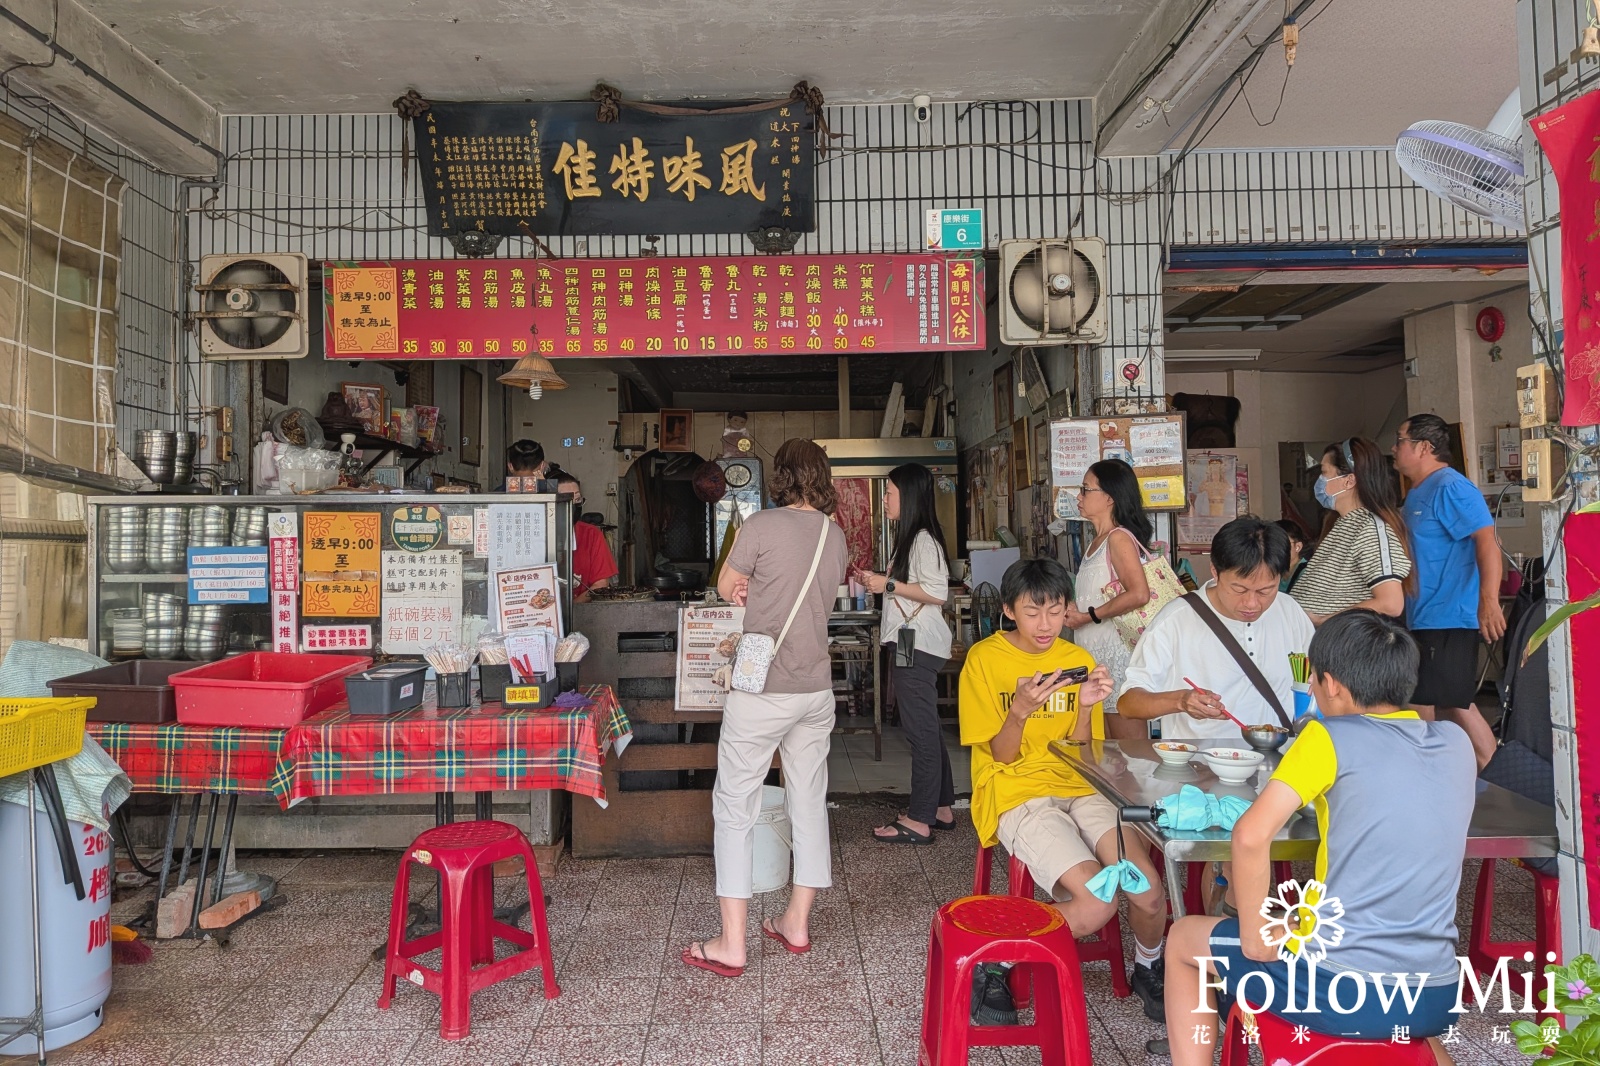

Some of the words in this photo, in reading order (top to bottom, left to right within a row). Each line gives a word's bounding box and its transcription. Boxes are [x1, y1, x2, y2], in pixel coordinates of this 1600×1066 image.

[779, 107, 791, 117] 祝
[552, 136, 766, 201] 風味特佳
[943, 214, 970, 223] 康樂街
[956, 228, 967, 242] 6
[832, 264, 848, 289] 米糕
[951, 263, 970, 278] 每
[402, 268, 417, 310] 燙青菜
[428, 268, 444, 310] 油條湯
[456, 268, 472, 309] 紫菜湯
[483, 268, 498, 309] 肉筋湯
[510, 268, 526, 308] 魚皮湯
[537, 268, 553, 308] 魚丸湯
[618, 268, 634, 307] 四神湯
[672, 266, 688, 306] 油豆腐
[806, 264, 821, 304] 肉燥飯
[859, 263, 875, 317] 竹葉米糕
[340, 291, 391, 303] 透早9:00
[645, 266, 661, 320] 肉燥油條
[592, 267, 607, 335] 四神肉筋湯
[359, 304, 372, 314] 至
[809, 306, 818, 315] 小
[836, 306, 845, 314] 小
[340, 317, 392, 328] 售完為止
[806, 314, 821, 327] 30
[833, 313, 848, 327] 40
[810, 327, 818, 336] 大
[836, 327, 845, 336] 大
[403, 340, 418, 354] 35
[430, 341, 445, 354] 30
[458, 340, 472, 354] 30
[485, 339, 499, 353] 50
[512, 339, 527, 353] 50
[539, 340, 554, 353] 35
[566, 340, 581, 353] 65
[593, 339, 607, 352] 55
[620, 339, 635, 351] 40
[646, 337, 662, 351] 20
[673, 337, 689, 350] 10
[699, 336, 716, 350] 15
[726, 336, 742, 350] 10
[753, 337, 768, 350] 55
[780, 336, 795, 349] 55
[806, 336, 821, 350] 40
[834, 337, 848, 349] 50
[860, 336, 875, 348] 45
[311, 538, 374, 550] 透早9:00
[334, 553, 350, 568] 至
[387, 554, 460, 565] 本店備有竹葉米
[513, 573, 540, 582] 店內公告
[388, 606, 453, 622] 紙碗裝湯
[701, 610, 733, 619] 店內公告
[278, 593, 292, 653] 謝絕推銷
[307, 628, 367, 639] 鈔票當面點清
[308, 638, 368, 648] 離櫃恕不負責
[506, 688, 539, 701] 請填單
